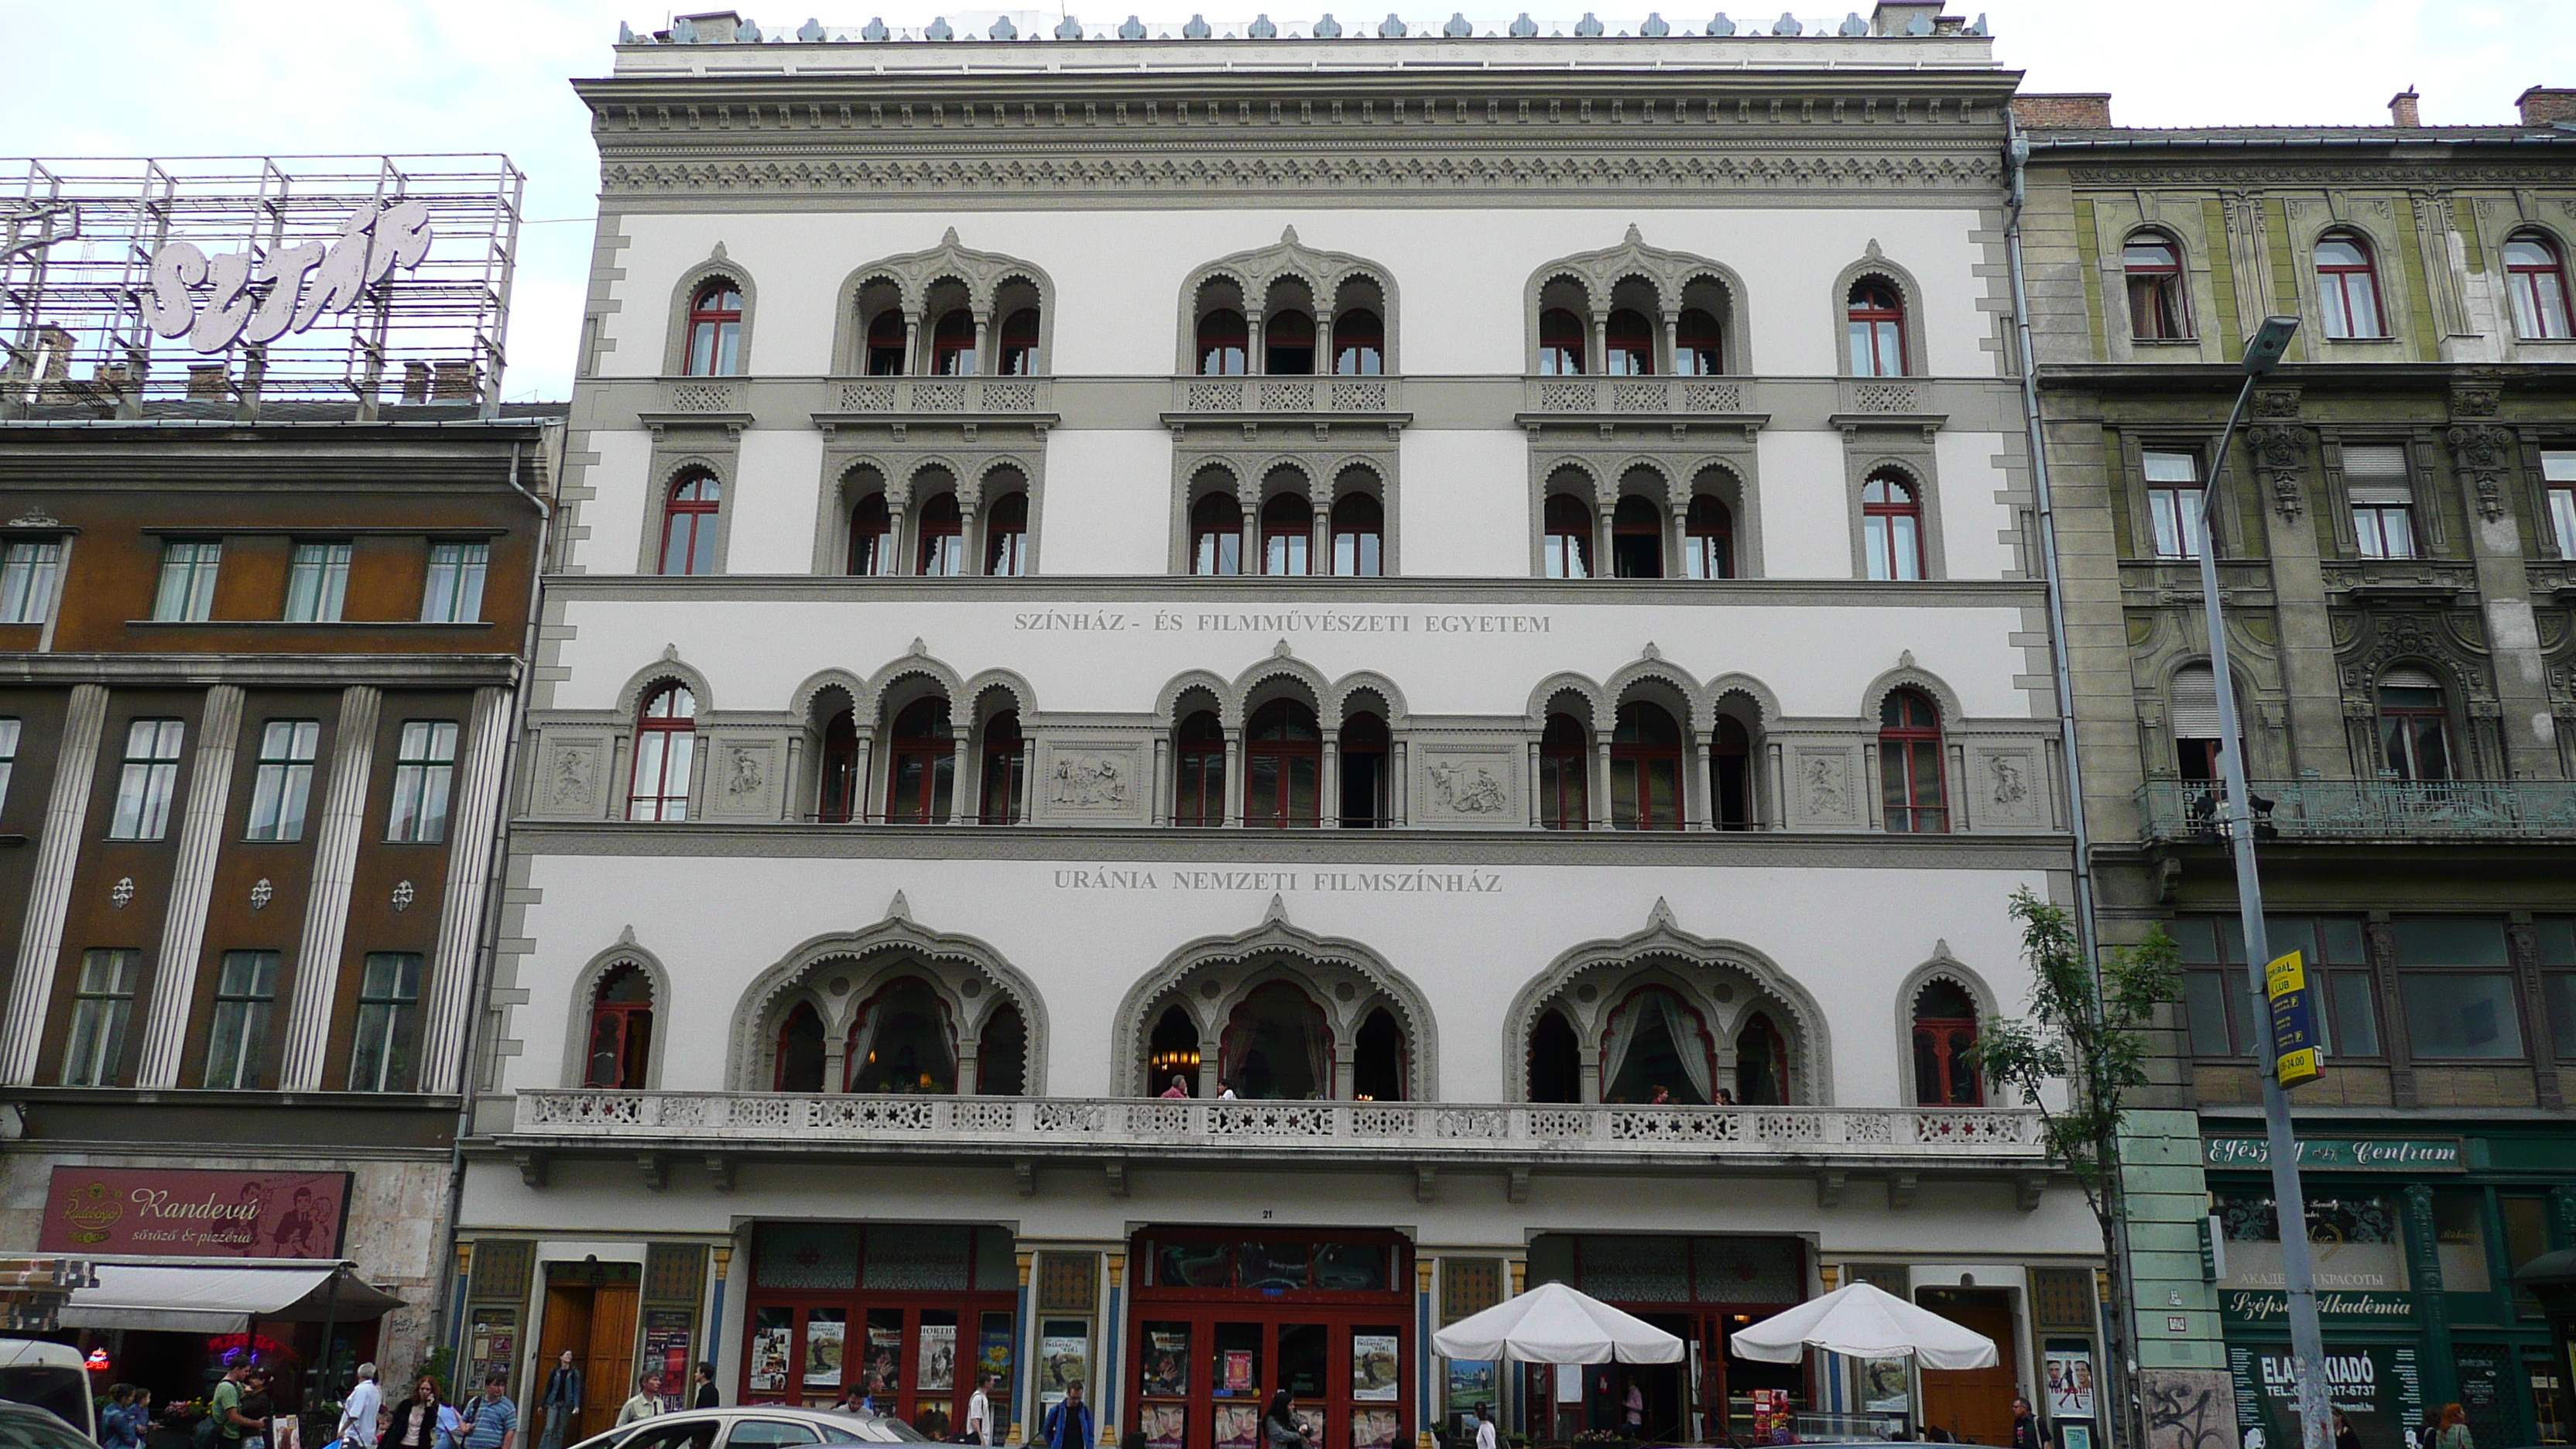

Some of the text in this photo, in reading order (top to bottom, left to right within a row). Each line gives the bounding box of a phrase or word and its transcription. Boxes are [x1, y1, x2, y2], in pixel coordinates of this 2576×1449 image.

[1154, 609, 1183, 631] ÉS
[1197, 610, 1410, 632] FILMMŰVÉSZETI
[1425, 615, 1551, 633] EGYETEM
[1054, 865, 1502, 892] URÁNIA NEMZETI FILMSZÍNHÁZ
[2209, 1139, 2305, 1163] Egészg
[2352, 1141, 2456, 1164] Centrum
[132, 1187, 262, 1221] Randevú
[1262, 1210, 1272, 1219] 21
[132, 1227, 254, 1247] söröző & pizzéria
[2321, 1273, 2384, 1286] КРАСОТЫ
[84, 1361, 110, 1370] OPEN
[2260, 1356, 2298, 1384] ELA
